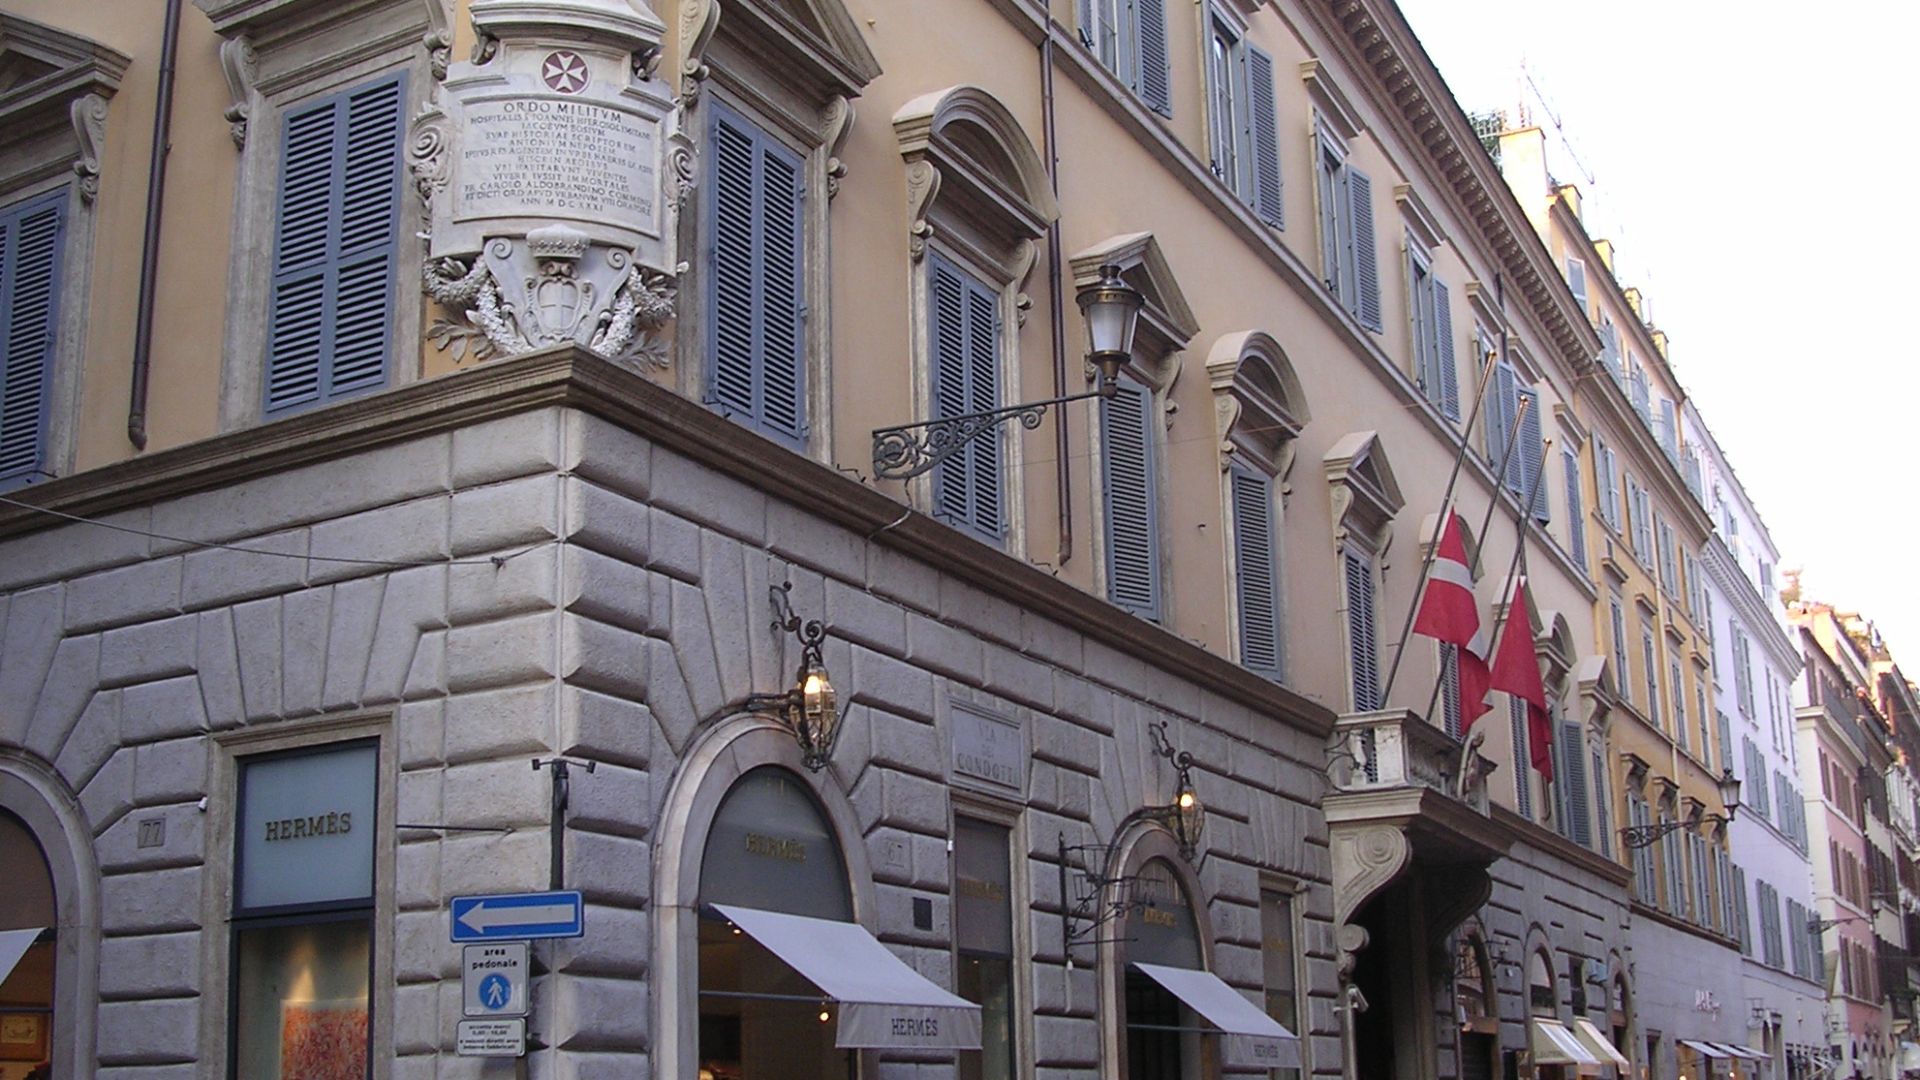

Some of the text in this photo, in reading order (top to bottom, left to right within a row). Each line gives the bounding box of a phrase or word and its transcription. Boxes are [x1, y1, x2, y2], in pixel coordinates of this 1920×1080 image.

[504, 101, 621, 123] ORDO MILITVM
[480, 180, 521, 190] CAROLO
[525, 180, 605, 195] ALDOBRANDINO
[484, 948, 506, 956] area
[472, 958, 518, 970] pedonale
